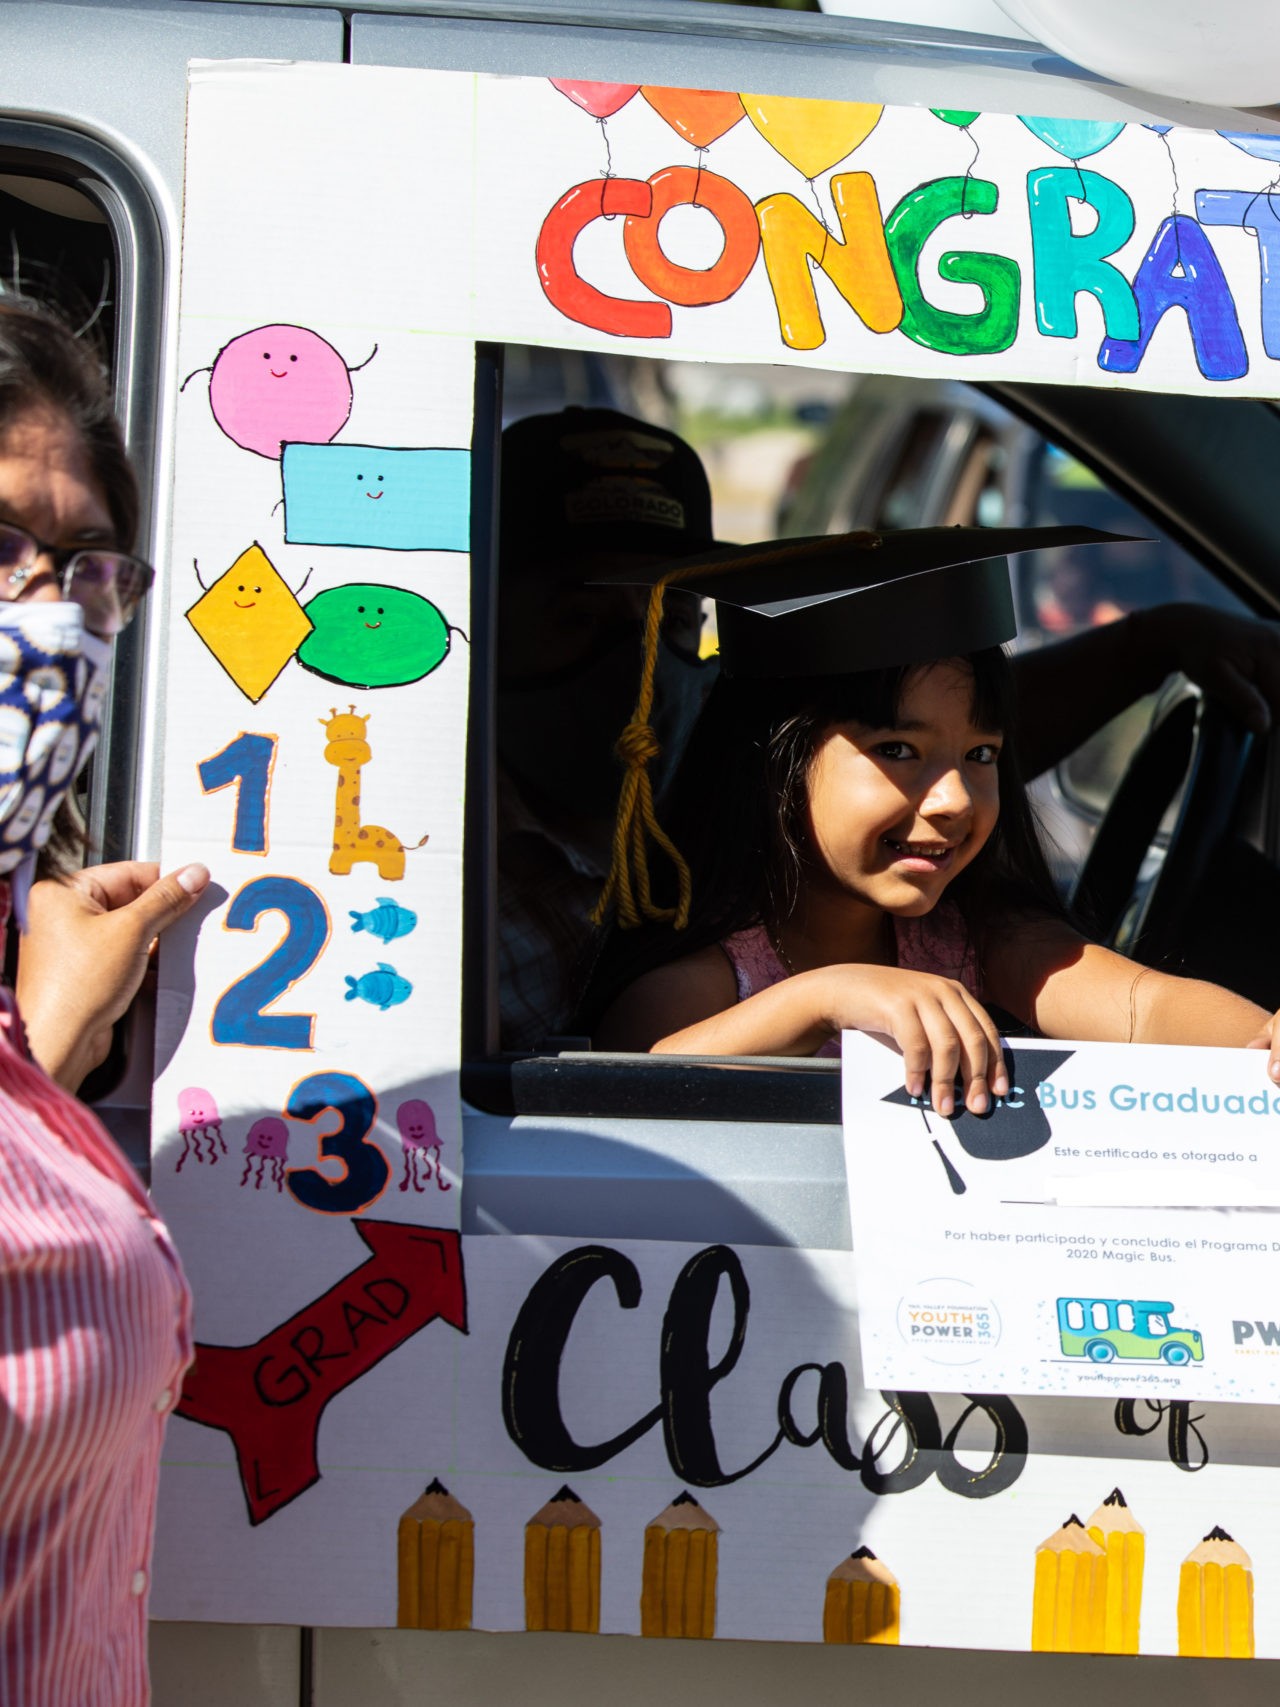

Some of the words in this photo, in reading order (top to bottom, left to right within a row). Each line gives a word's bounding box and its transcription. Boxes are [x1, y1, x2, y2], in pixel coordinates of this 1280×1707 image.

[572, 496, 681, 518] COLORADO
[197, 732, 280, 857] 1
[209, 874, 332, 1051] 2
[1038, 1081, 1097, 1111] Bus
[284, 1070, 392, 1215] 3
[1054, 1146, 1081, 1158] Este
[1084, 1147, 1158, 1160] certificado
[1162, 1151, 1177, 1161] es
[1181, 1149, 1244, 1164] otorgado
[1248, 1154, 1258, 1163] a
[944, 1230, 966, 1241] Por
[970, 1230, 1011, 1242] haber
[1015, 1232, 1096, 1246] participado
[1099, 1236, 1108, 1247] y
[1112, 1237, 1181, 1249] concludio
[1185, 1239, 1197, 1249] el
[1201, 1240, 1268, 1253] Programa
[1066, 1249, 1098, 1260] 2020
[1102, 1250, 1145, 1263] Magic
[1150, 1251, 1177, 1263] Bus.
[908, 1311, 973, 1324] YOUTH
[975, 1312, 991, 1338] 365
[253, 1277, 411, 1407] GRAD
[911, 1325, 973, 1338] POWER
[502, 1243, 1029, 1499] Class
